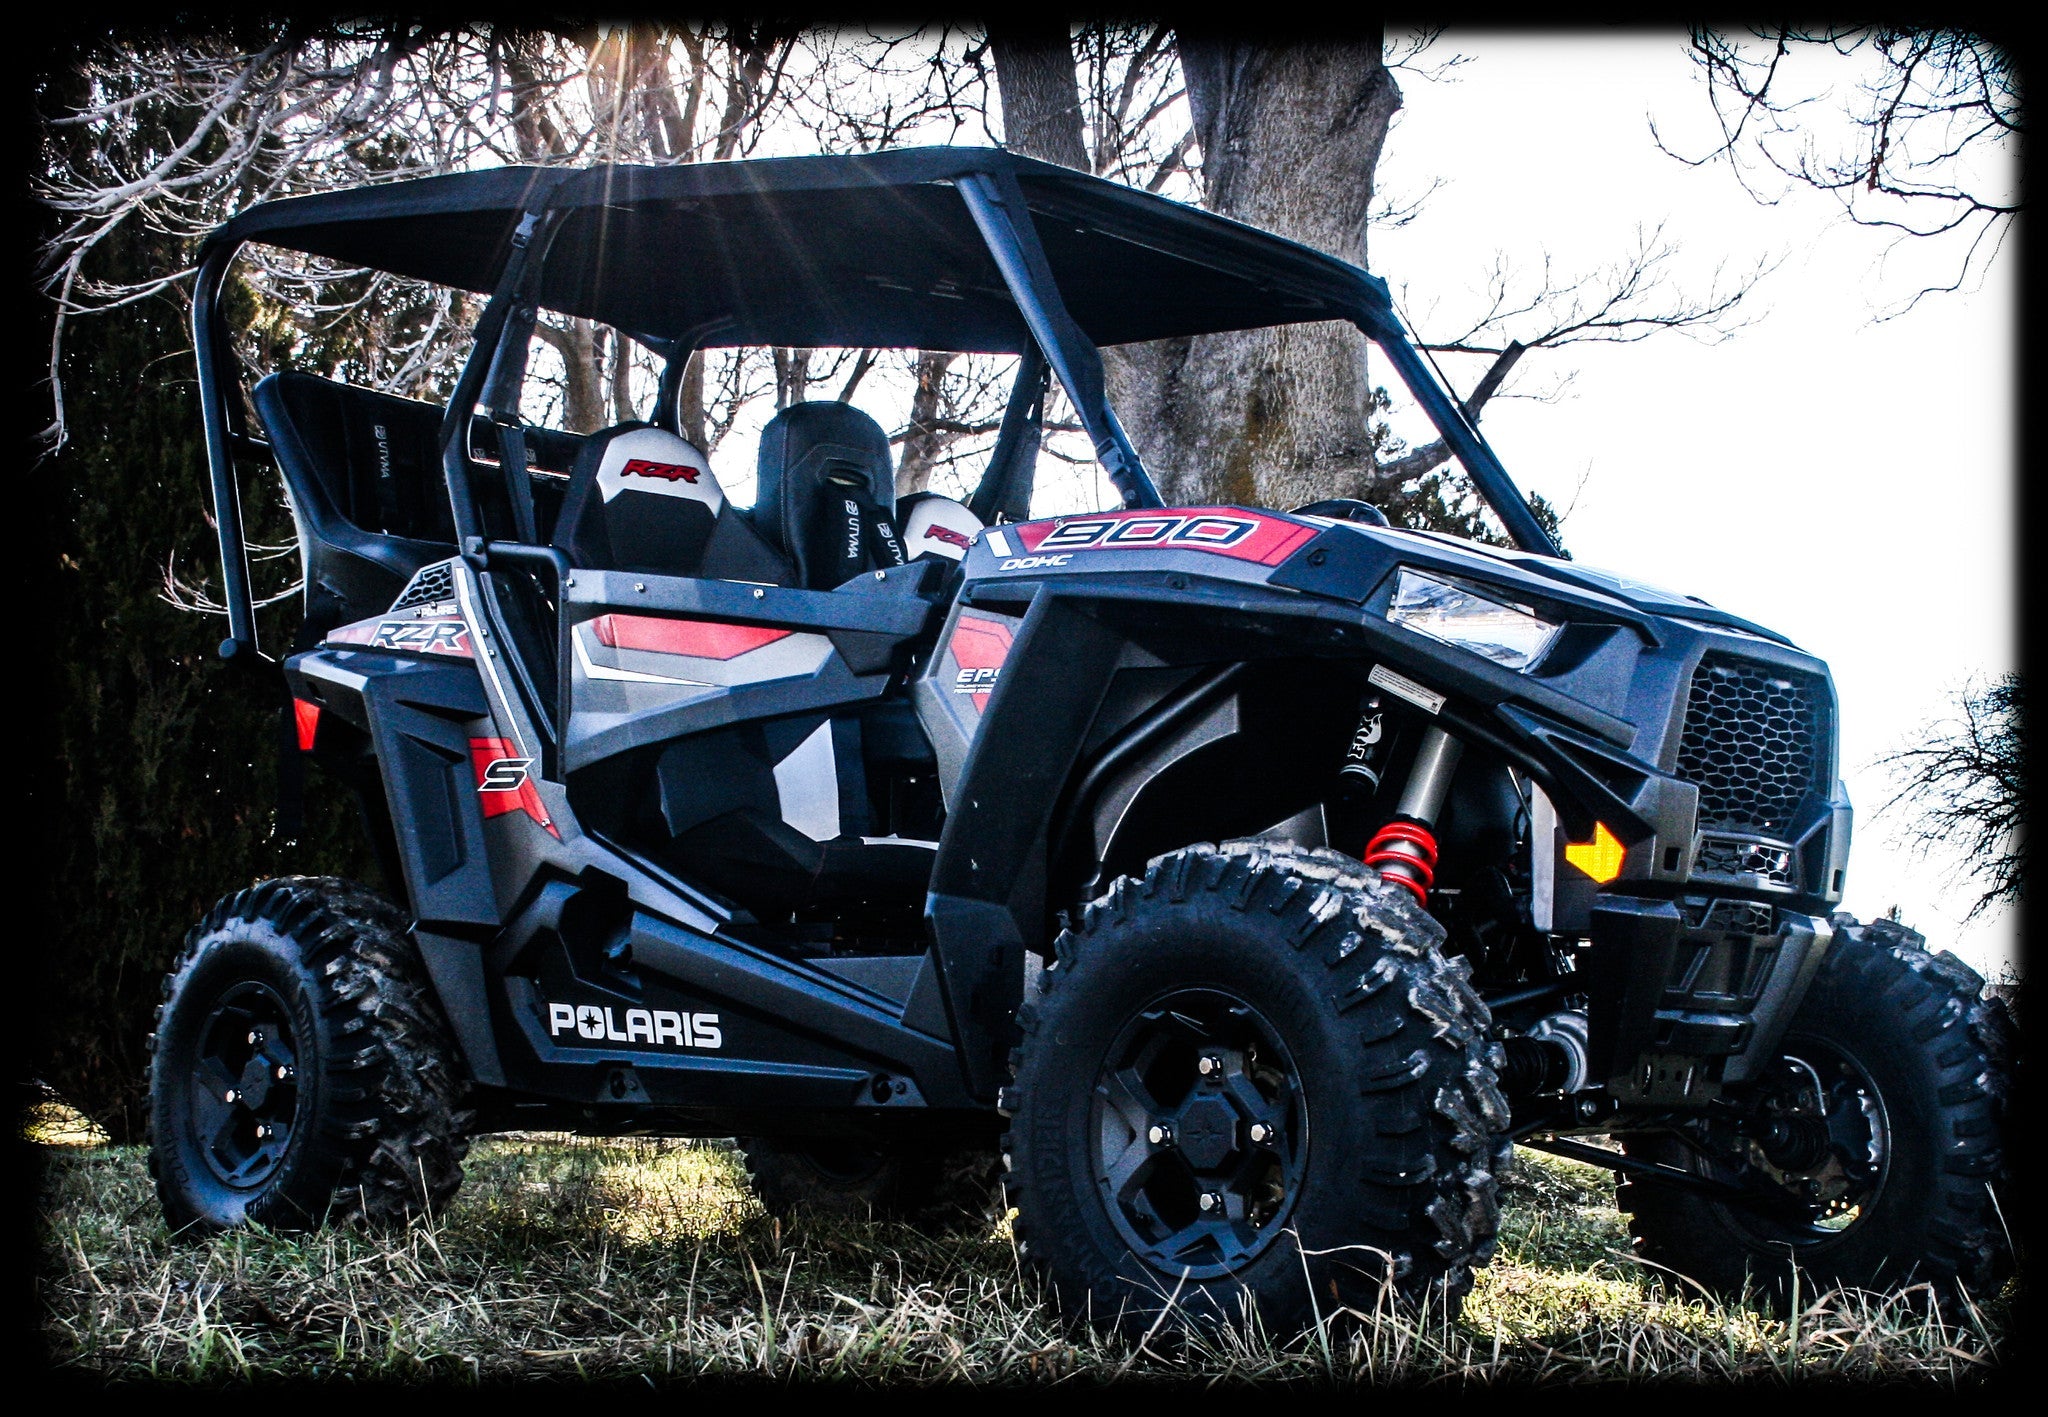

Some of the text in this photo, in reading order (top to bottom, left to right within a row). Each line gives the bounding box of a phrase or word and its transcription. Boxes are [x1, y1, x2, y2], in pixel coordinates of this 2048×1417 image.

[378, 441, 390, 478] UTVMA
[620, 459, 701, 484] RZR
[848, 518, 859, 558] UTVMA
[1034, 515, 1261, 551] 900
[887, 540, 905, 566] UTV
[1000, 554, 1073, 571] DOHC
[368, 619, 470, 653] RZR
[477, 758, 536, 792] S
[549, 1003, 722, 1049] POLARIS
